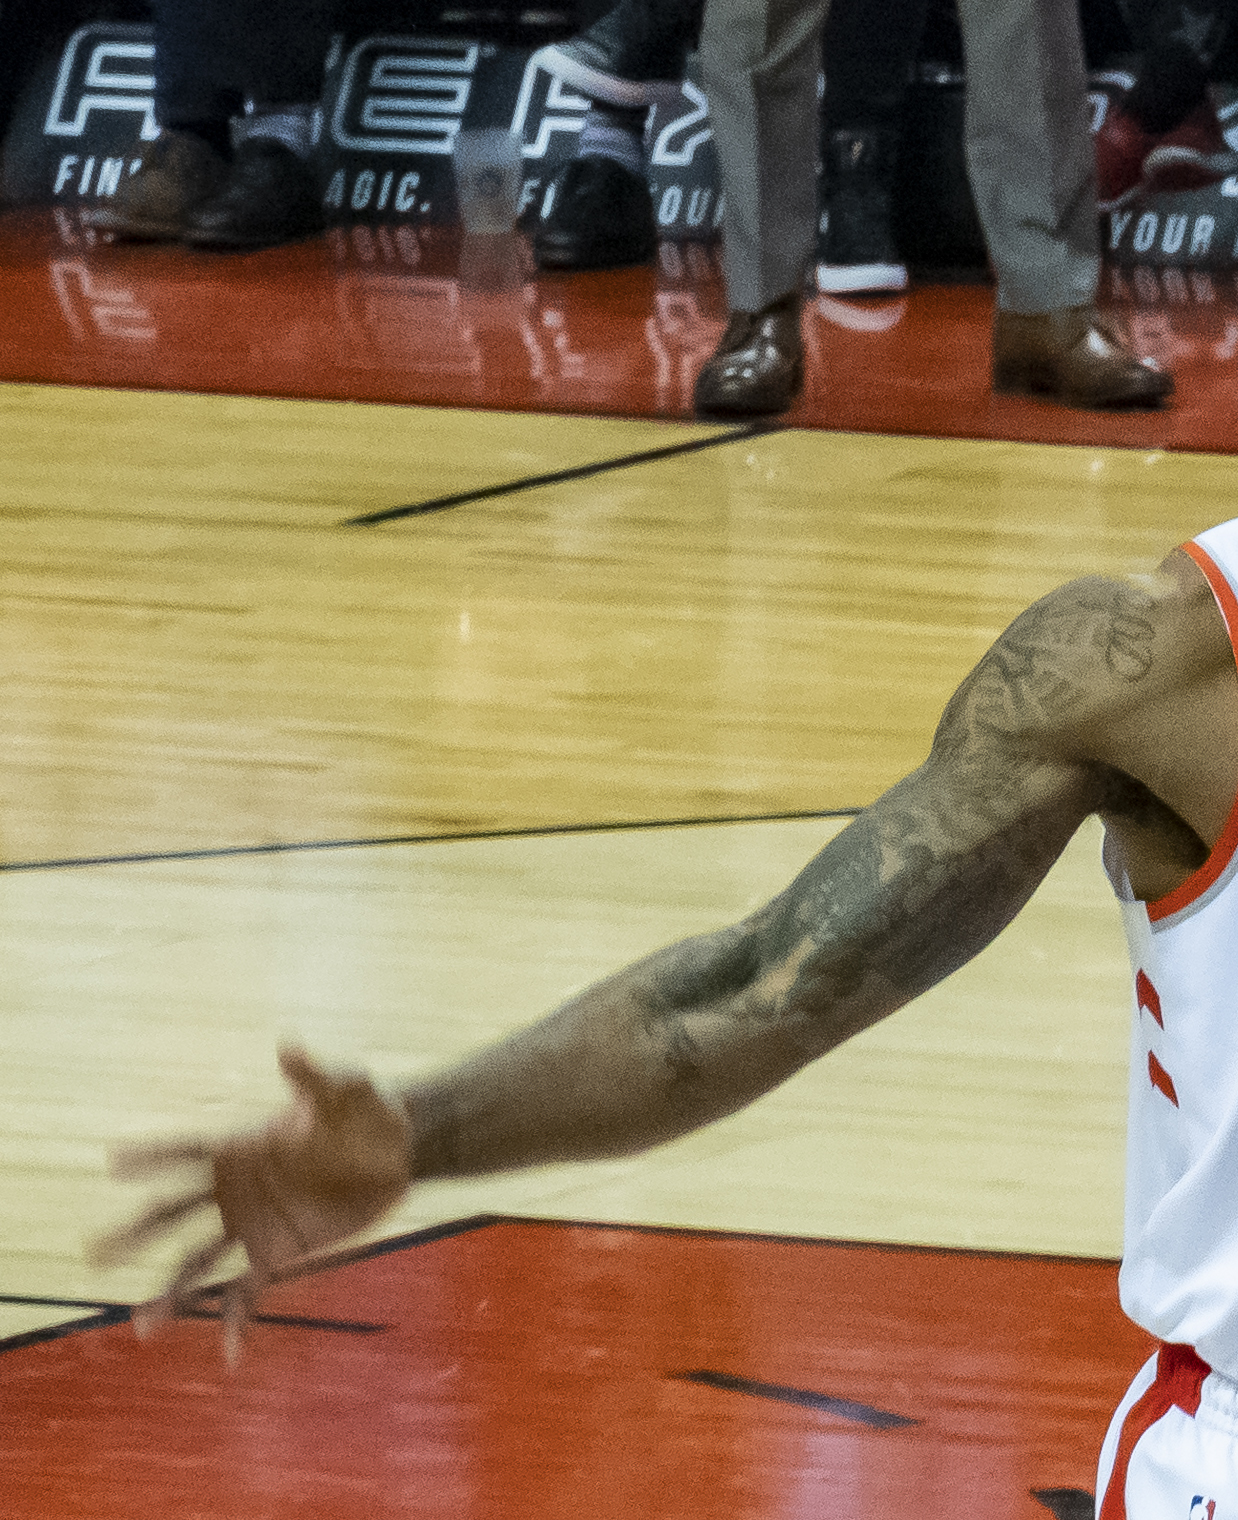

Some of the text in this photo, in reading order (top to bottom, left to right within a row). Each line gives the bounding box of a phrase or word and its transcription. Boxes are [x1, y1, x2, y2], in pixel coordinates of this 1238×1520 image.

[52, 154, 431, 214] FIN AGIC.
[1109, 210, 1216, 257] YOUR
